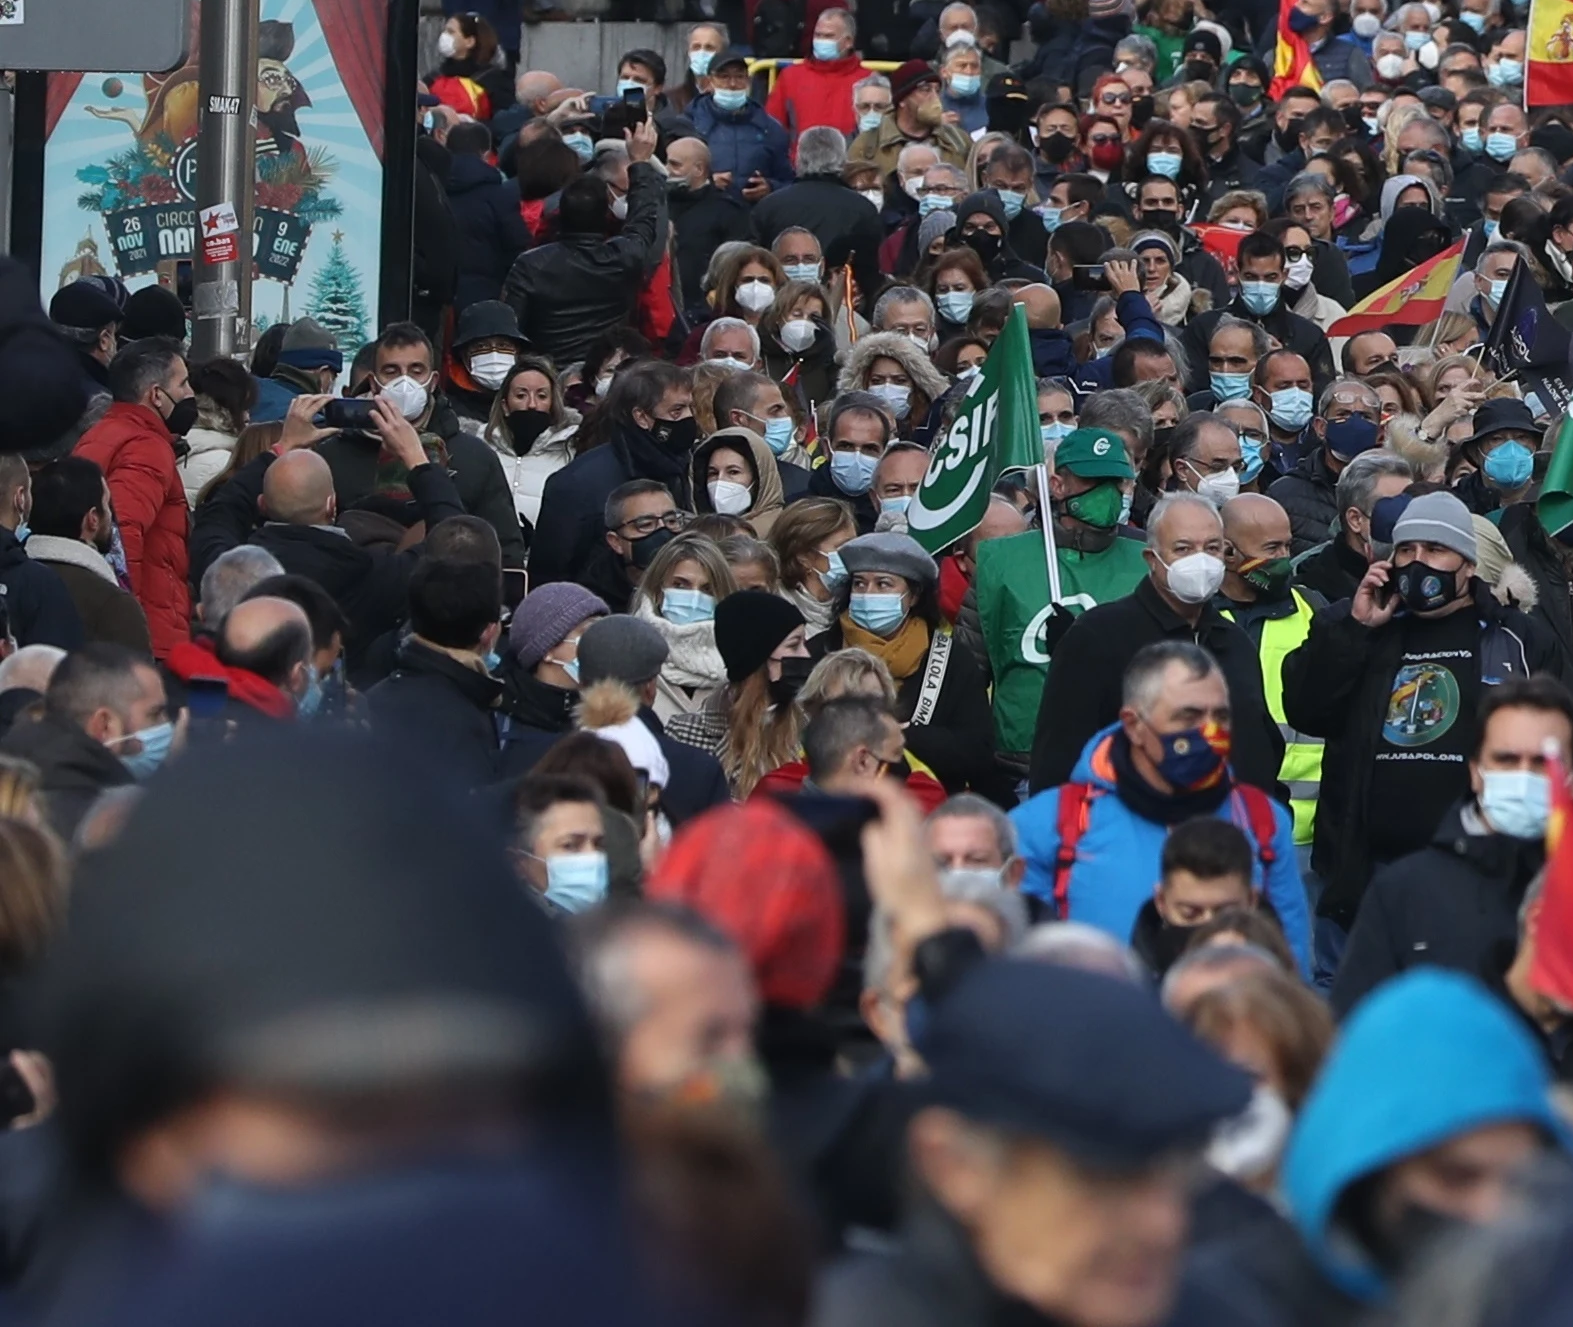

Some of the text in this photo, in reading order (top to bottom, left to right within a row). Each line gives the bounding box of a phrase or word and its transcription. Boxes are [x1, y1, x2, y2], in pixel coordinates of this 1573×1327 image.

[208, 95, 241, 115] SMAK47
[122, 216, 141, 234] 26
[277, 221, 288, 237] 9
[117, 232, 144, 252] NOV
[273, 237, 299, 255] ENE
